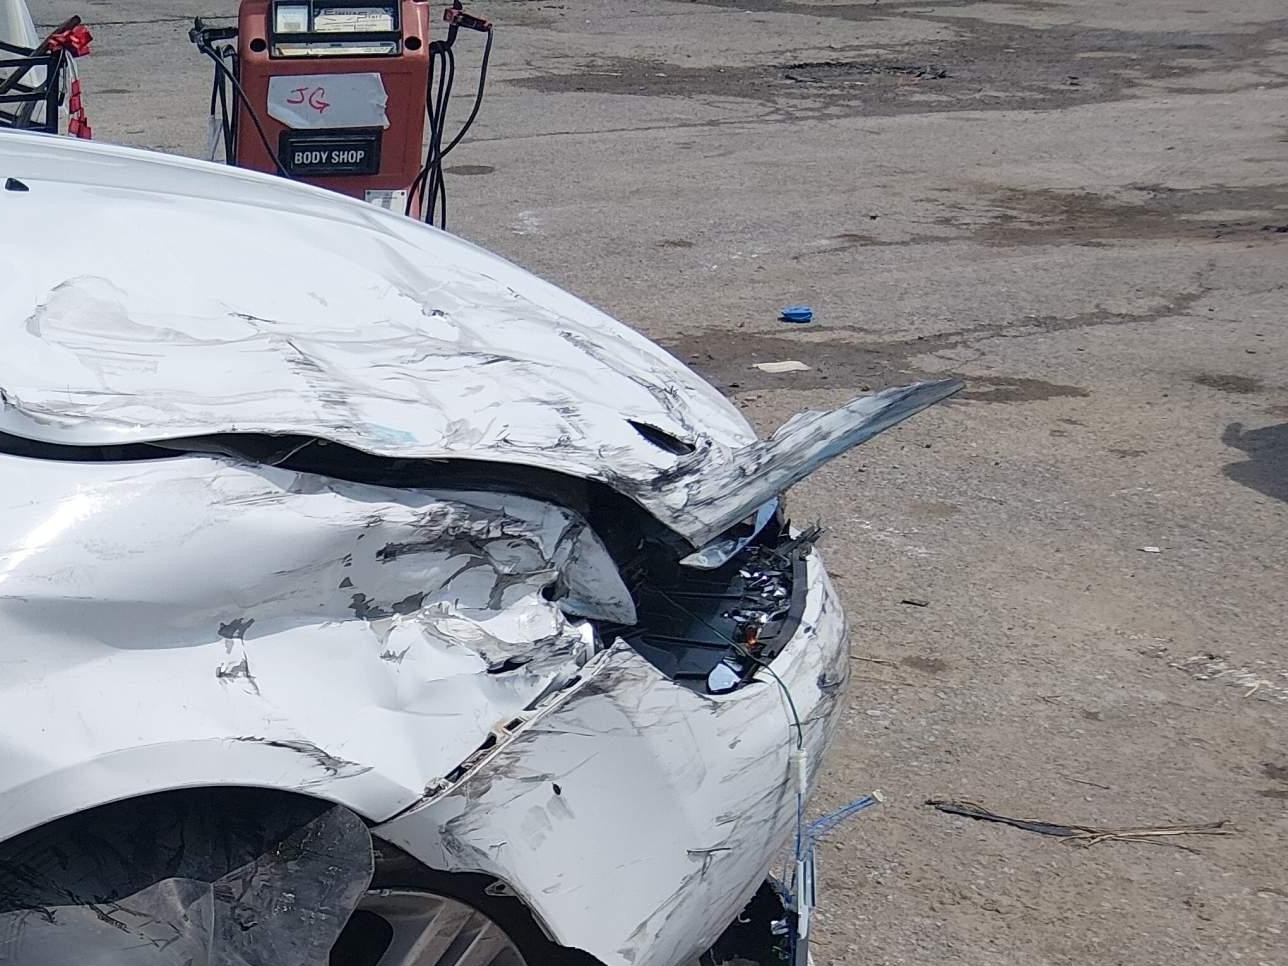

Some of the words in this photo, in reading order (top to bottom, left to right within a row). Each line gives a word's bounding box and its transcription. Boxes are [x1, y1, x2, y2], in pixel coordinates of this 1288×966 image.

[287, 87, 330, 114] JG
[294, 151, 329, 164] BODY
[331, 150, 365, 163] SHOP
